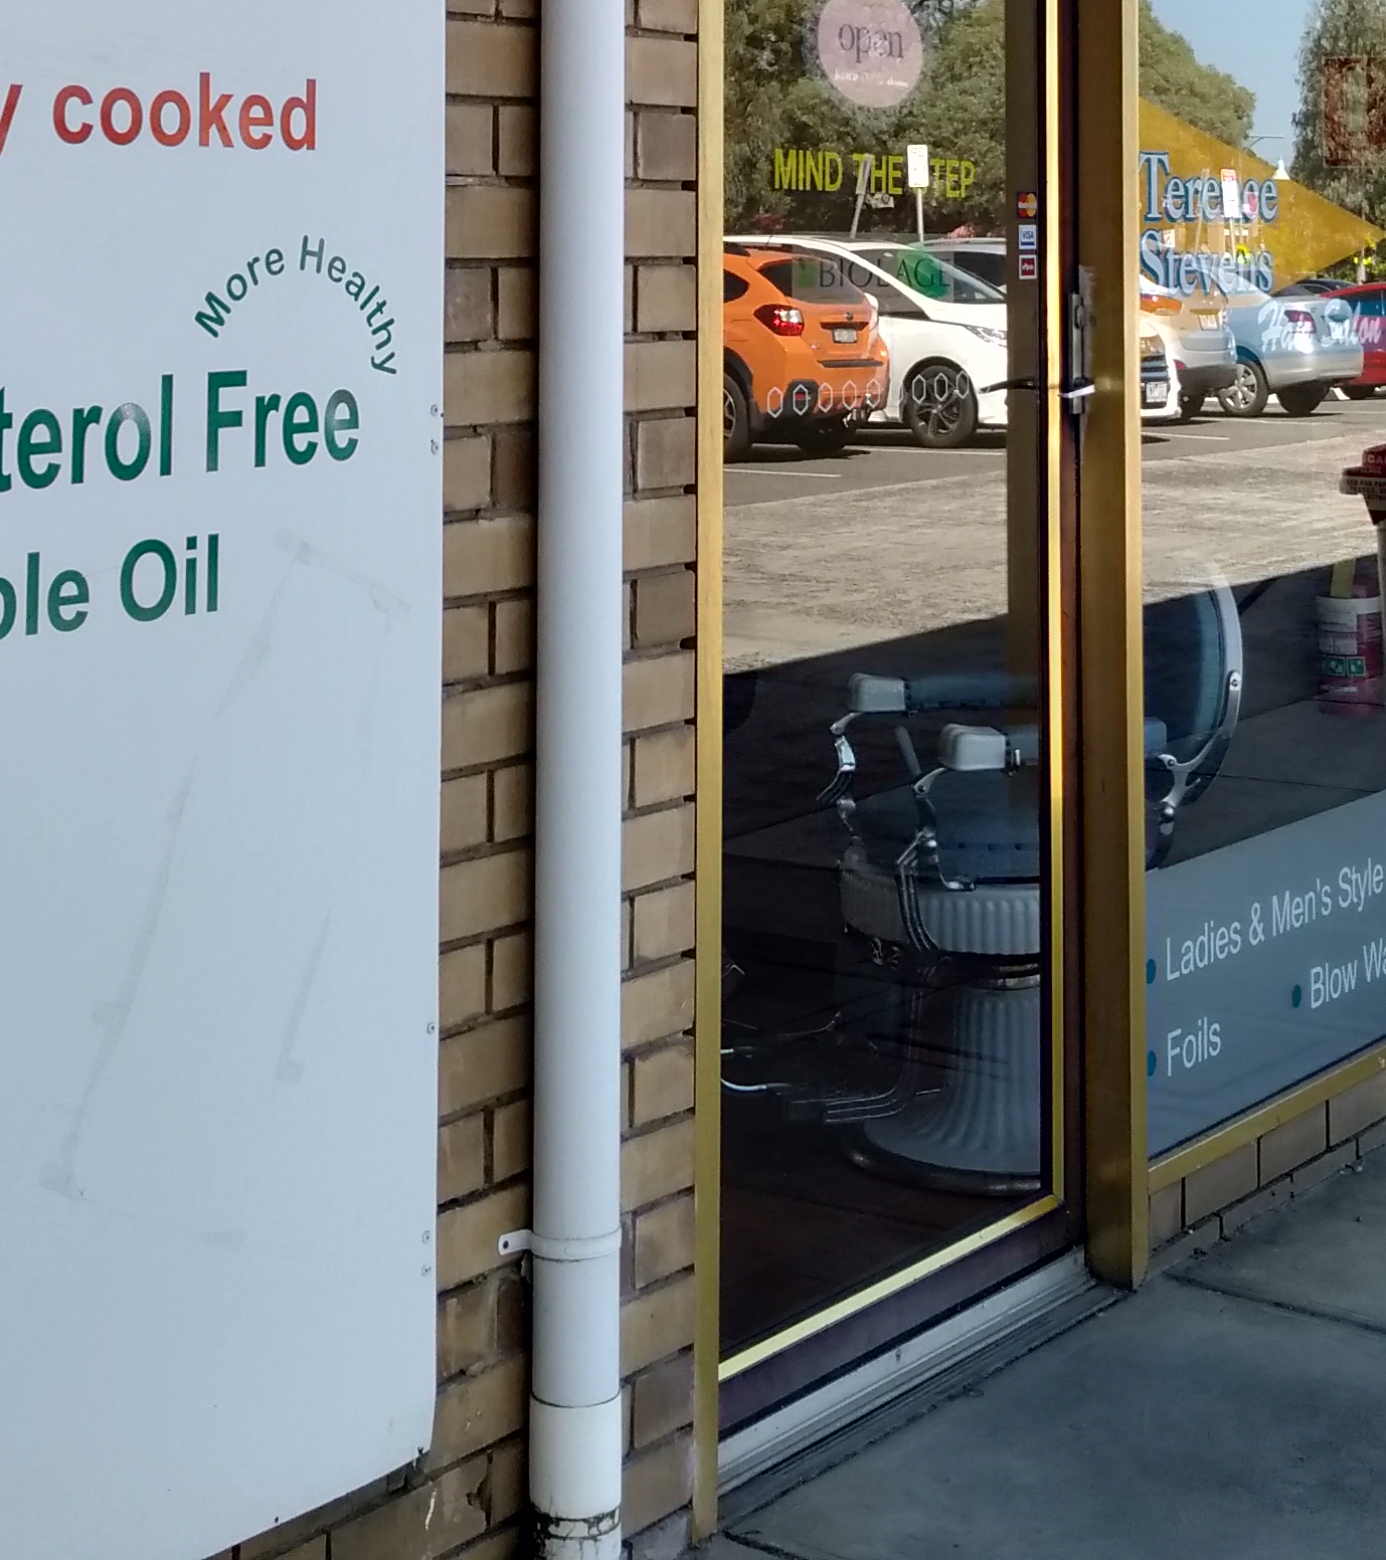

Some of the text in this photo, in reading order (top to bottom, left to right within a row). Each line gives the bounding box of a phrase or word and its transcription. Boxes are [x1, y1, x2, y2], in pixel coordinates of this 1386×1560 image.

[838, 24, 904, 63] open
[53, 72, 316, 150] cooked
[774, 148, 975, 197] MIND THE TEP
[1139, 151, 1278, 223] Terece
[819, 257, 950, 288] BIOLAGE
[1141, 228, 1273, 297] Stevens
[195, 235, 397, 374] More Healthy
[1257, 298, 1382, 354] Hair Salon
[206, 370, 359, 472] Free
[120, 534, 219, 622] Oil
[1166, 918, 1242, 981] Ladies
[1249, 902, 1265, 946] &
[1272, 879, 1332, 938] Men's
[1338, 856, 1384, 912] Style
[1310, 959, 1358, 1010] Blow
[1166, 1017, 1222, 1077] Foils
